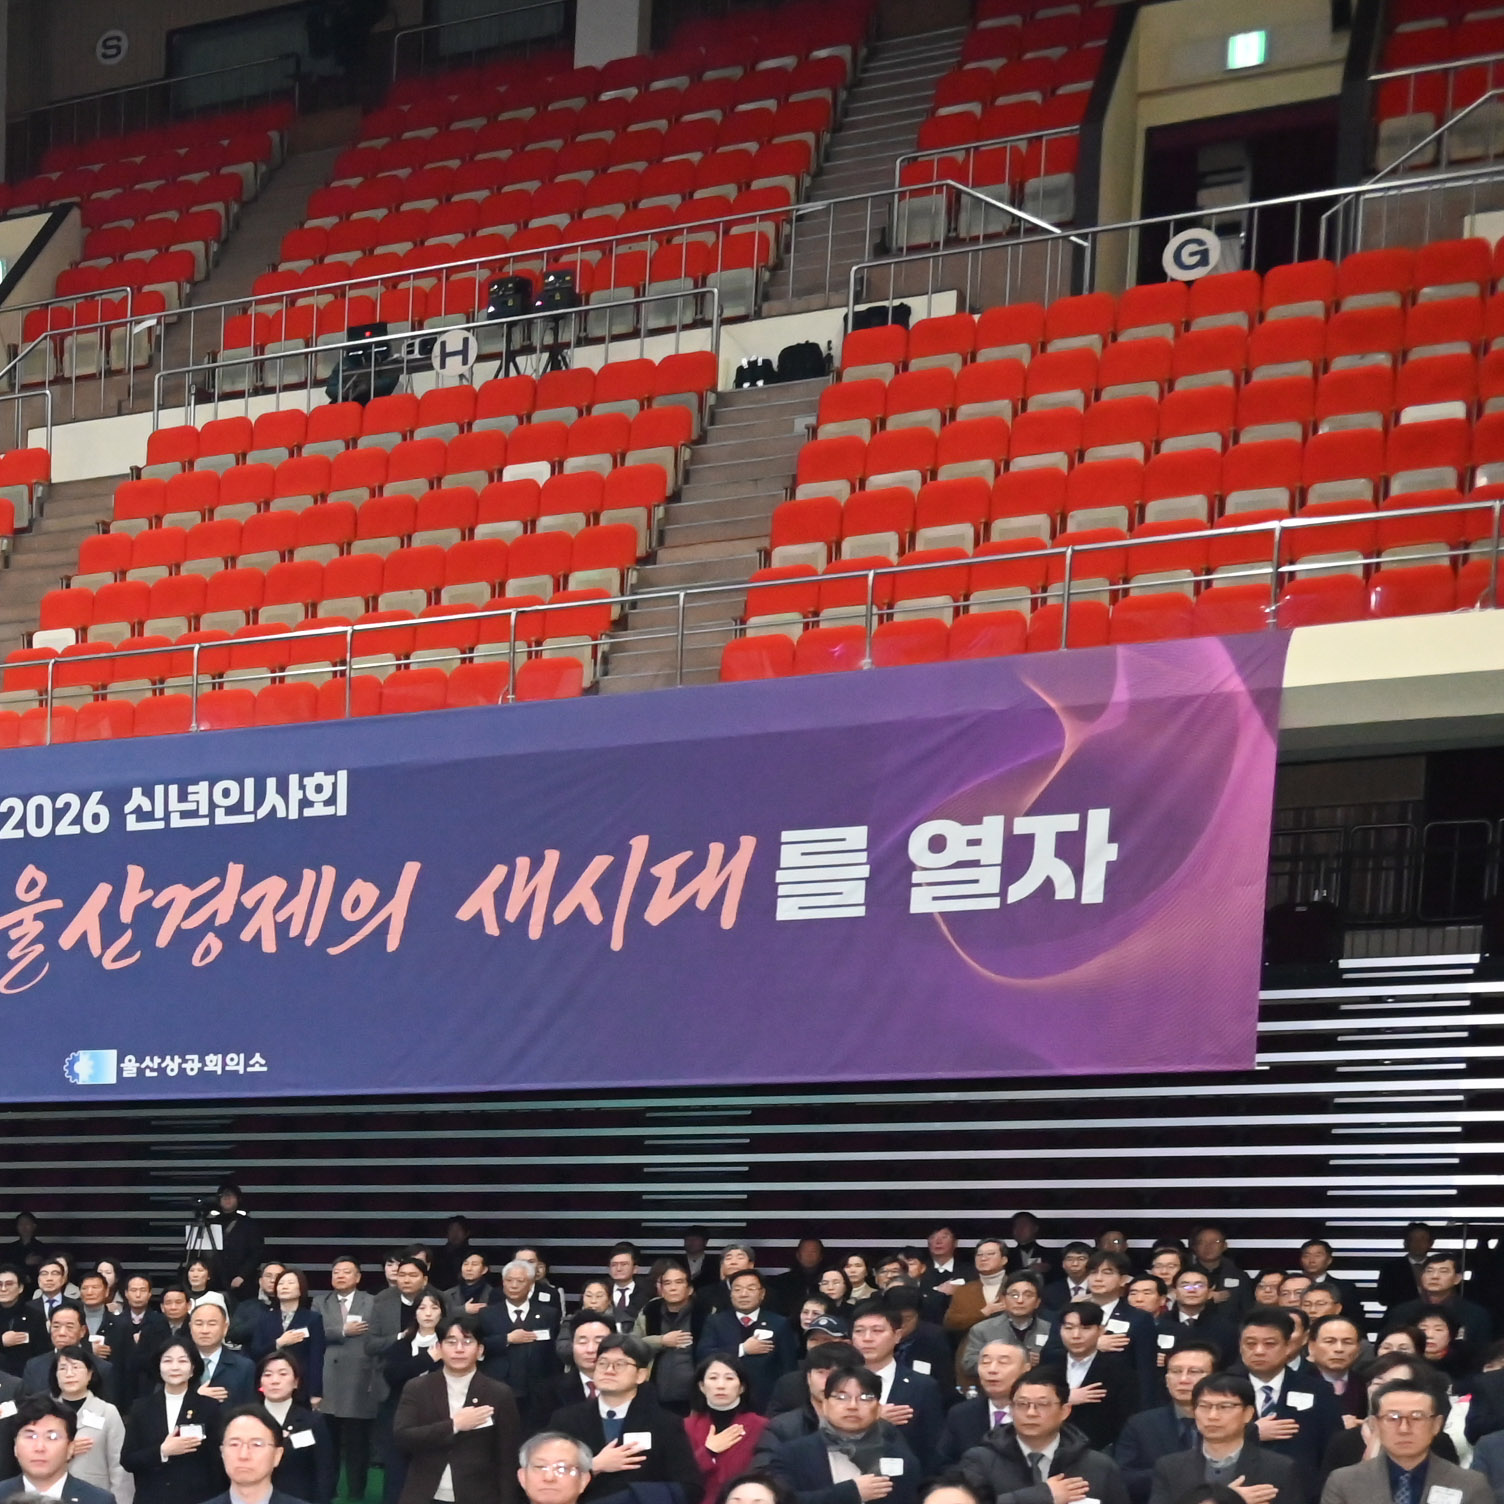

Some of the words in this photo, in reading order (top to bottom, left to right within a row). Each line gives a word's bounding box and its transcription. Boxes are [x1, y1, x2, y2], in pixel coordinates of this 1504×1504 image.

[101, 35, 122, 60] S
[1173, 238, 1210, 271] G
[439, 336, 469, 371] H
[124, 770, 348, 832] 신년인사회
[455, 825, 870, 951] 새시대를
[906, 808, 1118, 914] 열자
[120, 1053, 268, 1078] 울산상공회의소
